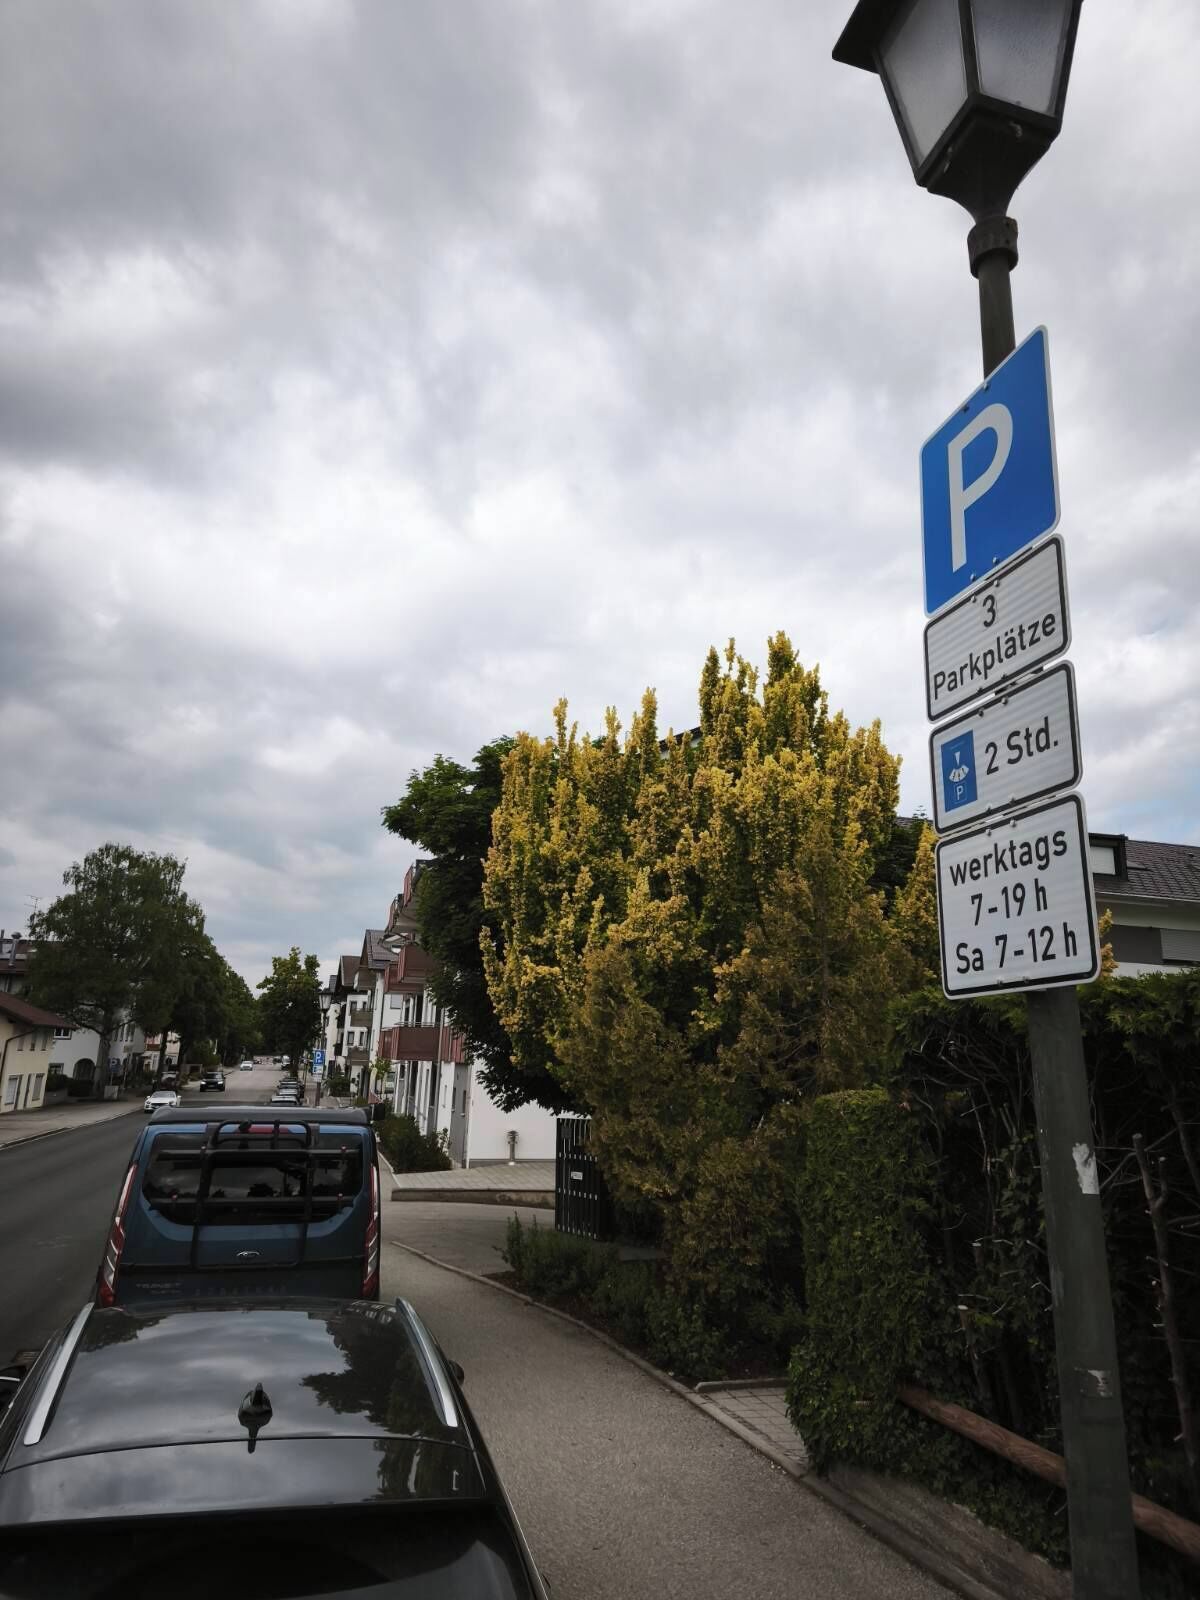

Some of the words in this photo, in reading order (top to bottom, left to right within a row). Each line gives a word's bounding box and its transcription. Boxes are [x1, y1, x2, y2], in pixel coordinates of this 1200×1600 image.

[948, 402, 1014, 573] P
[982, 594, 997, 628] 3
[933, 612, 1056, 700] Parkplätze
[984, 741, 999, 776] 2
[1006, 715, 1059, 765] Std.
[956, 785, 964, 801] P
[949, 830, 1068, 887] werktags
[970, 882, 1026, 926] 7-19
[1034, 878, 1048, 912] h
[955, 942, 985, 974] Sa
[994, 925, 1057, 968] 7-12
[1063, 921, 1078, 957] h
